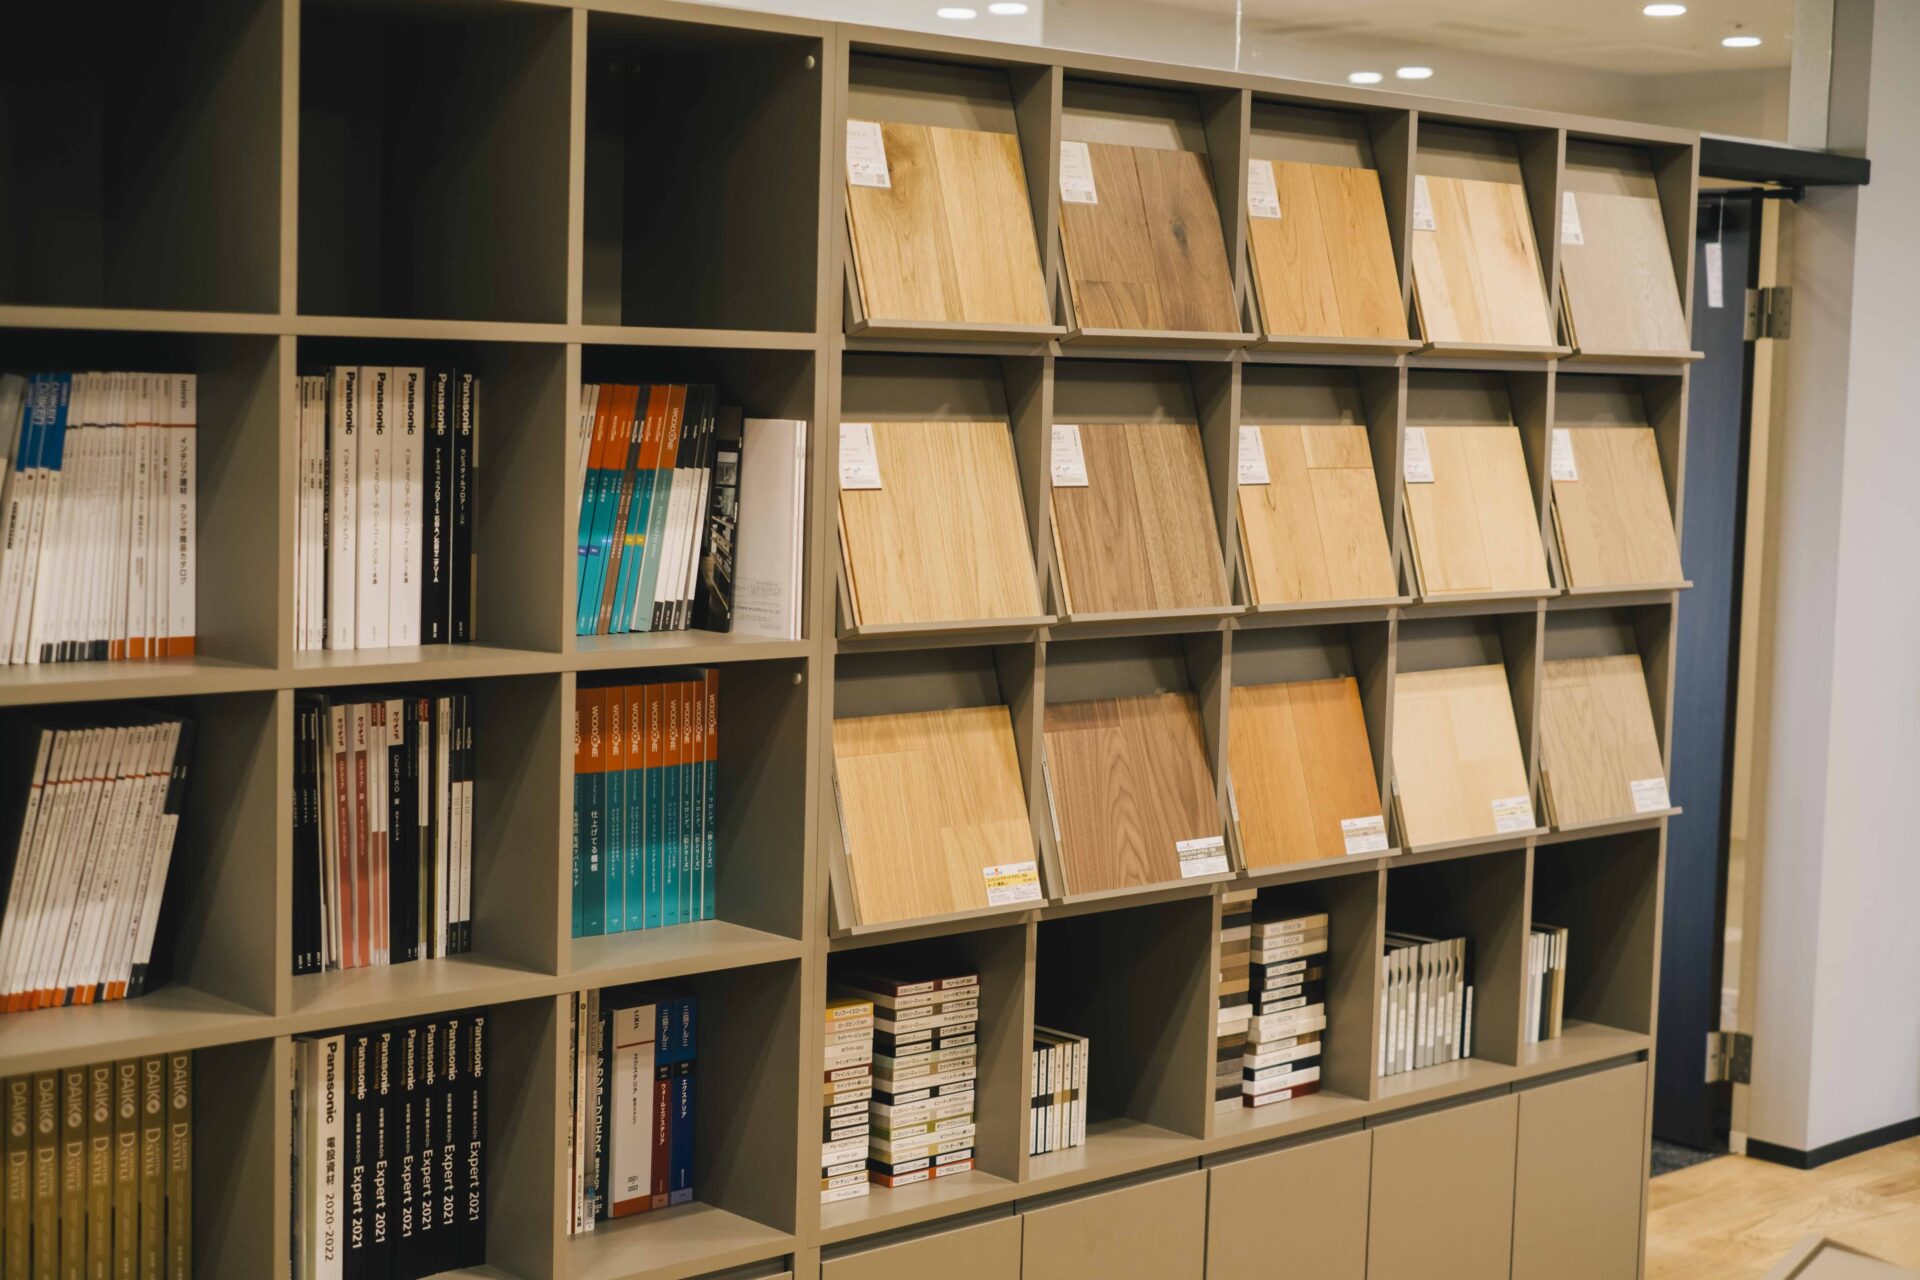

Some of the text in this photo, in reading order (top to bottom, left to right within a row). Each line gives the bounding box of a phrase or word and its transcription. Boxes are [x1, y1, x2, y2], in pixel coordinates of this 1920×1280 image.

[346, 372, 355, 435] Panasonic
[376, 372, 386, 435] Panasonic
[408, 372, 417, 435] Panasonic
[437, 373, 447, 436] Panasonic
[462, 374, 472, 436] Panasonic
[668, 407, 678, 450] WOODONE
[591, 706, 600, 757] WOODONE
[612, 704, 621, 756] WOODONE
[632, 702, 640, 754] WOODONE
[651, 701, 660, 752] WOODONE
[670, 700, 678, 751] WOODONE
[357, 1037, 368, 1100] Panasonic
[380, 1033, 391, 1095] Panasonic
[407, 1029, 416, 1091] Panasonic
[427, 1024, 436, 1086] Panasonic
[448, 1020, 458, 1081] Panasonic
[474, 1018, 484, 1078] Panasonic
[11, 1082, 27, 1137] DAIKO
[39, 1078, 54, 1134] DAIKO
[67, 1073, 82, 1128] DAIKO
[94, 1068, 109, 1123] DAIKO
[121, 1065, 135, 1119] DAIKO
[146, 1060, 161, 1114] DAIKO
[173, 1056, 187, 1110] DAIKO
[326, 1041, 337, 1124] Panasonic
[350, 1166, 365, 1214] Expert
[374, 1160, 387, 1208] Expert
[401, 1156, 414, 1204] Expert
[421, 1149, 433, 1197] Expert
[442, 1144, 455, 1192] Expert
[468, 1141, 481, 1188] Expert
[324, 1193, 335, 1262] 2020-2022
[376, 1213, 385, 1243] 2021
[403, 1208, 412, 1238] 2021
[422, 1201, 432, 1231] 2021
[444, 1195, 453, 1225] 2021
[469, 1191, 479, 1221] 2021
[352, 1218, 363, 1249] 2021
